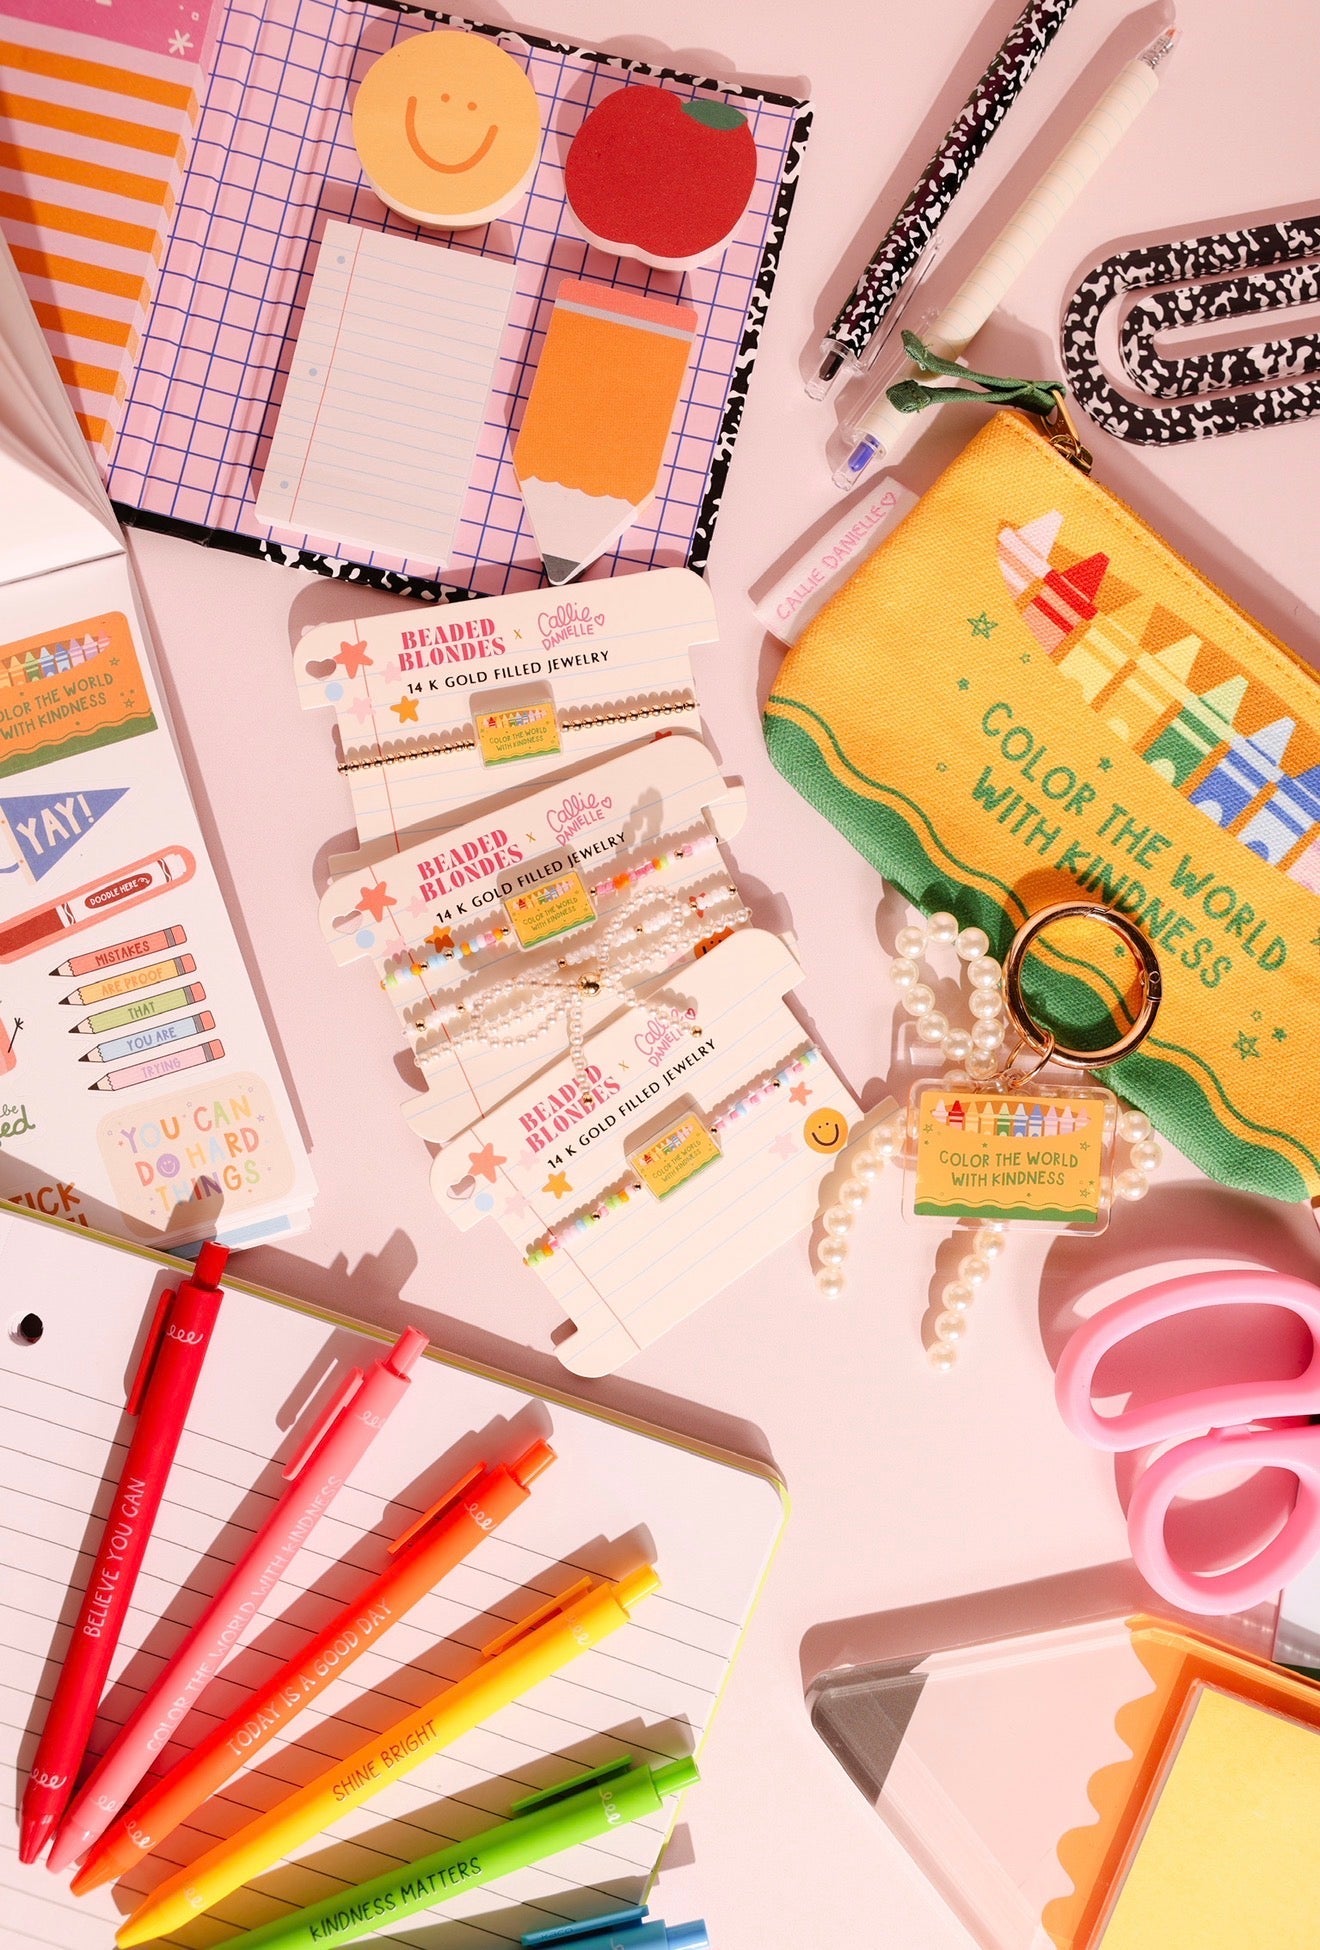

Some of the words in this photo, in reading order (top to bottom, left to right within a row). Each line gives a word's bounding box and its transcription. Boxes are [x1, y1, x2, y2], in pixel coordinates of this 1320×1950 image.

[777, 568, 825, 619] CALLIE
[822, 505, 886, 569] DANIELLE
[401, 618, 495, 649] BEADED
[538, 602, 592, 637] Callie
[541, 623, 594, 651] DANIELLE
[398, 637, 506, 671] BLONDES
[407, 683, 423, 694] 14
[429, 680, 439, 691] K
[445, 671, 487, 687] GOLD
[494, 662, 541, 679] FILLED
[547, 650, 609, 673] JEWELRY
[34, 688, 60, 709] THE
[63, 673, 113, 696] WORLD
[0, 718, 36, 740] WITH
[37, 692, 107, 728] KINDNESS
[489, 735, 511, 744] COLOR
[512, 732, 524, 740] THE
[524, 727, 547, 736] WORLD
[16, 793, 95, 856] YAY!
[546, 792, 599, 833] Callie
[556, 809, 605, 847] DANIELLE
[417, 829, 508, 881] BEADED
[981, 701, 1097, 816] COLOR
[1095, 802, 1173, 872] THE
[1170, 857, 1289, 973] WORLD
[90, 888, 120, 906] DOODLE
[119, 880, 139, 893] HERE
[419, 844, 524, 903] BLONDES
[436, 909, 452, 924] 14
[456, 903, 467, 915] K
[471, 882, 513, 907] GOLD
[517, 861, 563, 887] FILLED
[567, 832, 626, 868] JEWELRY
[970, 765, 1063, 857] WITH
[1053, 839, 1233, 988] KINDNESS
[95, 940, 150, 967] MISTAKES
[102, 982, 122, 996] ARE
[125, 968, 163, 989] PROOF
[128, 1001, 156, 1019] THAT
[126, 1035, 153, 1051] YOU
[156, 1026, 177, 1042] ARE
[648, 1028, 685, 1067] DANIELL
[141, 1058, 181, 1079] TRYING
[120, 1116, 180, 1154] YOU
[193, 1095, 252, 1132] CAN
[526, 1076, 621, 1153] BLONDES
[547, 1154, 564, 1169] 14
[565, 1145, 577, 1157] K
[578, 1115, 617, 1146] GOLD
[618, 1081, 660, 1117] FILLED
[662, 1038, 716, 1086] JEWELRY
[185, 1127, 260, 1169] HARD
[939, 1150, 990, 1168] COLOR
[995, 1152, 1021, 1167] THE
[1027, 1152, 1079, 1168] WORLD
[155, 1160, 260, 1211] THINGS
[951, 1172, 988, 1187] WITH
[992, 1171, 1065, 1187] KINDNESS
[83, 1567, 120, 1638] BELIEVE
[106, 1522, 134, 1561] YOU
[121, 1477, 147, 1518] CAN
[147, 1696, 188, 1753] COLOR
[185, 1663, 215, 1694] THE
[208, 1601, 257, 1662] WORLD
[251, 1555, 285, 1601] WITH
[282, 1475, 344, 1553] KINDNESS
[226, 1701, 281, 1756] TODAY
[281, 1686, 301, 1708] IS
[299, 1673, 316, 1692] A
[313, 1630, 359, 1677] GOOD
[356, 1598, 392, 1635] DAY
[332, 1760, 381, 1802] SHINE
[381, 1719, 439, 1769] BRIGHT
[401, 1856, 482, 1905] MATTERS
